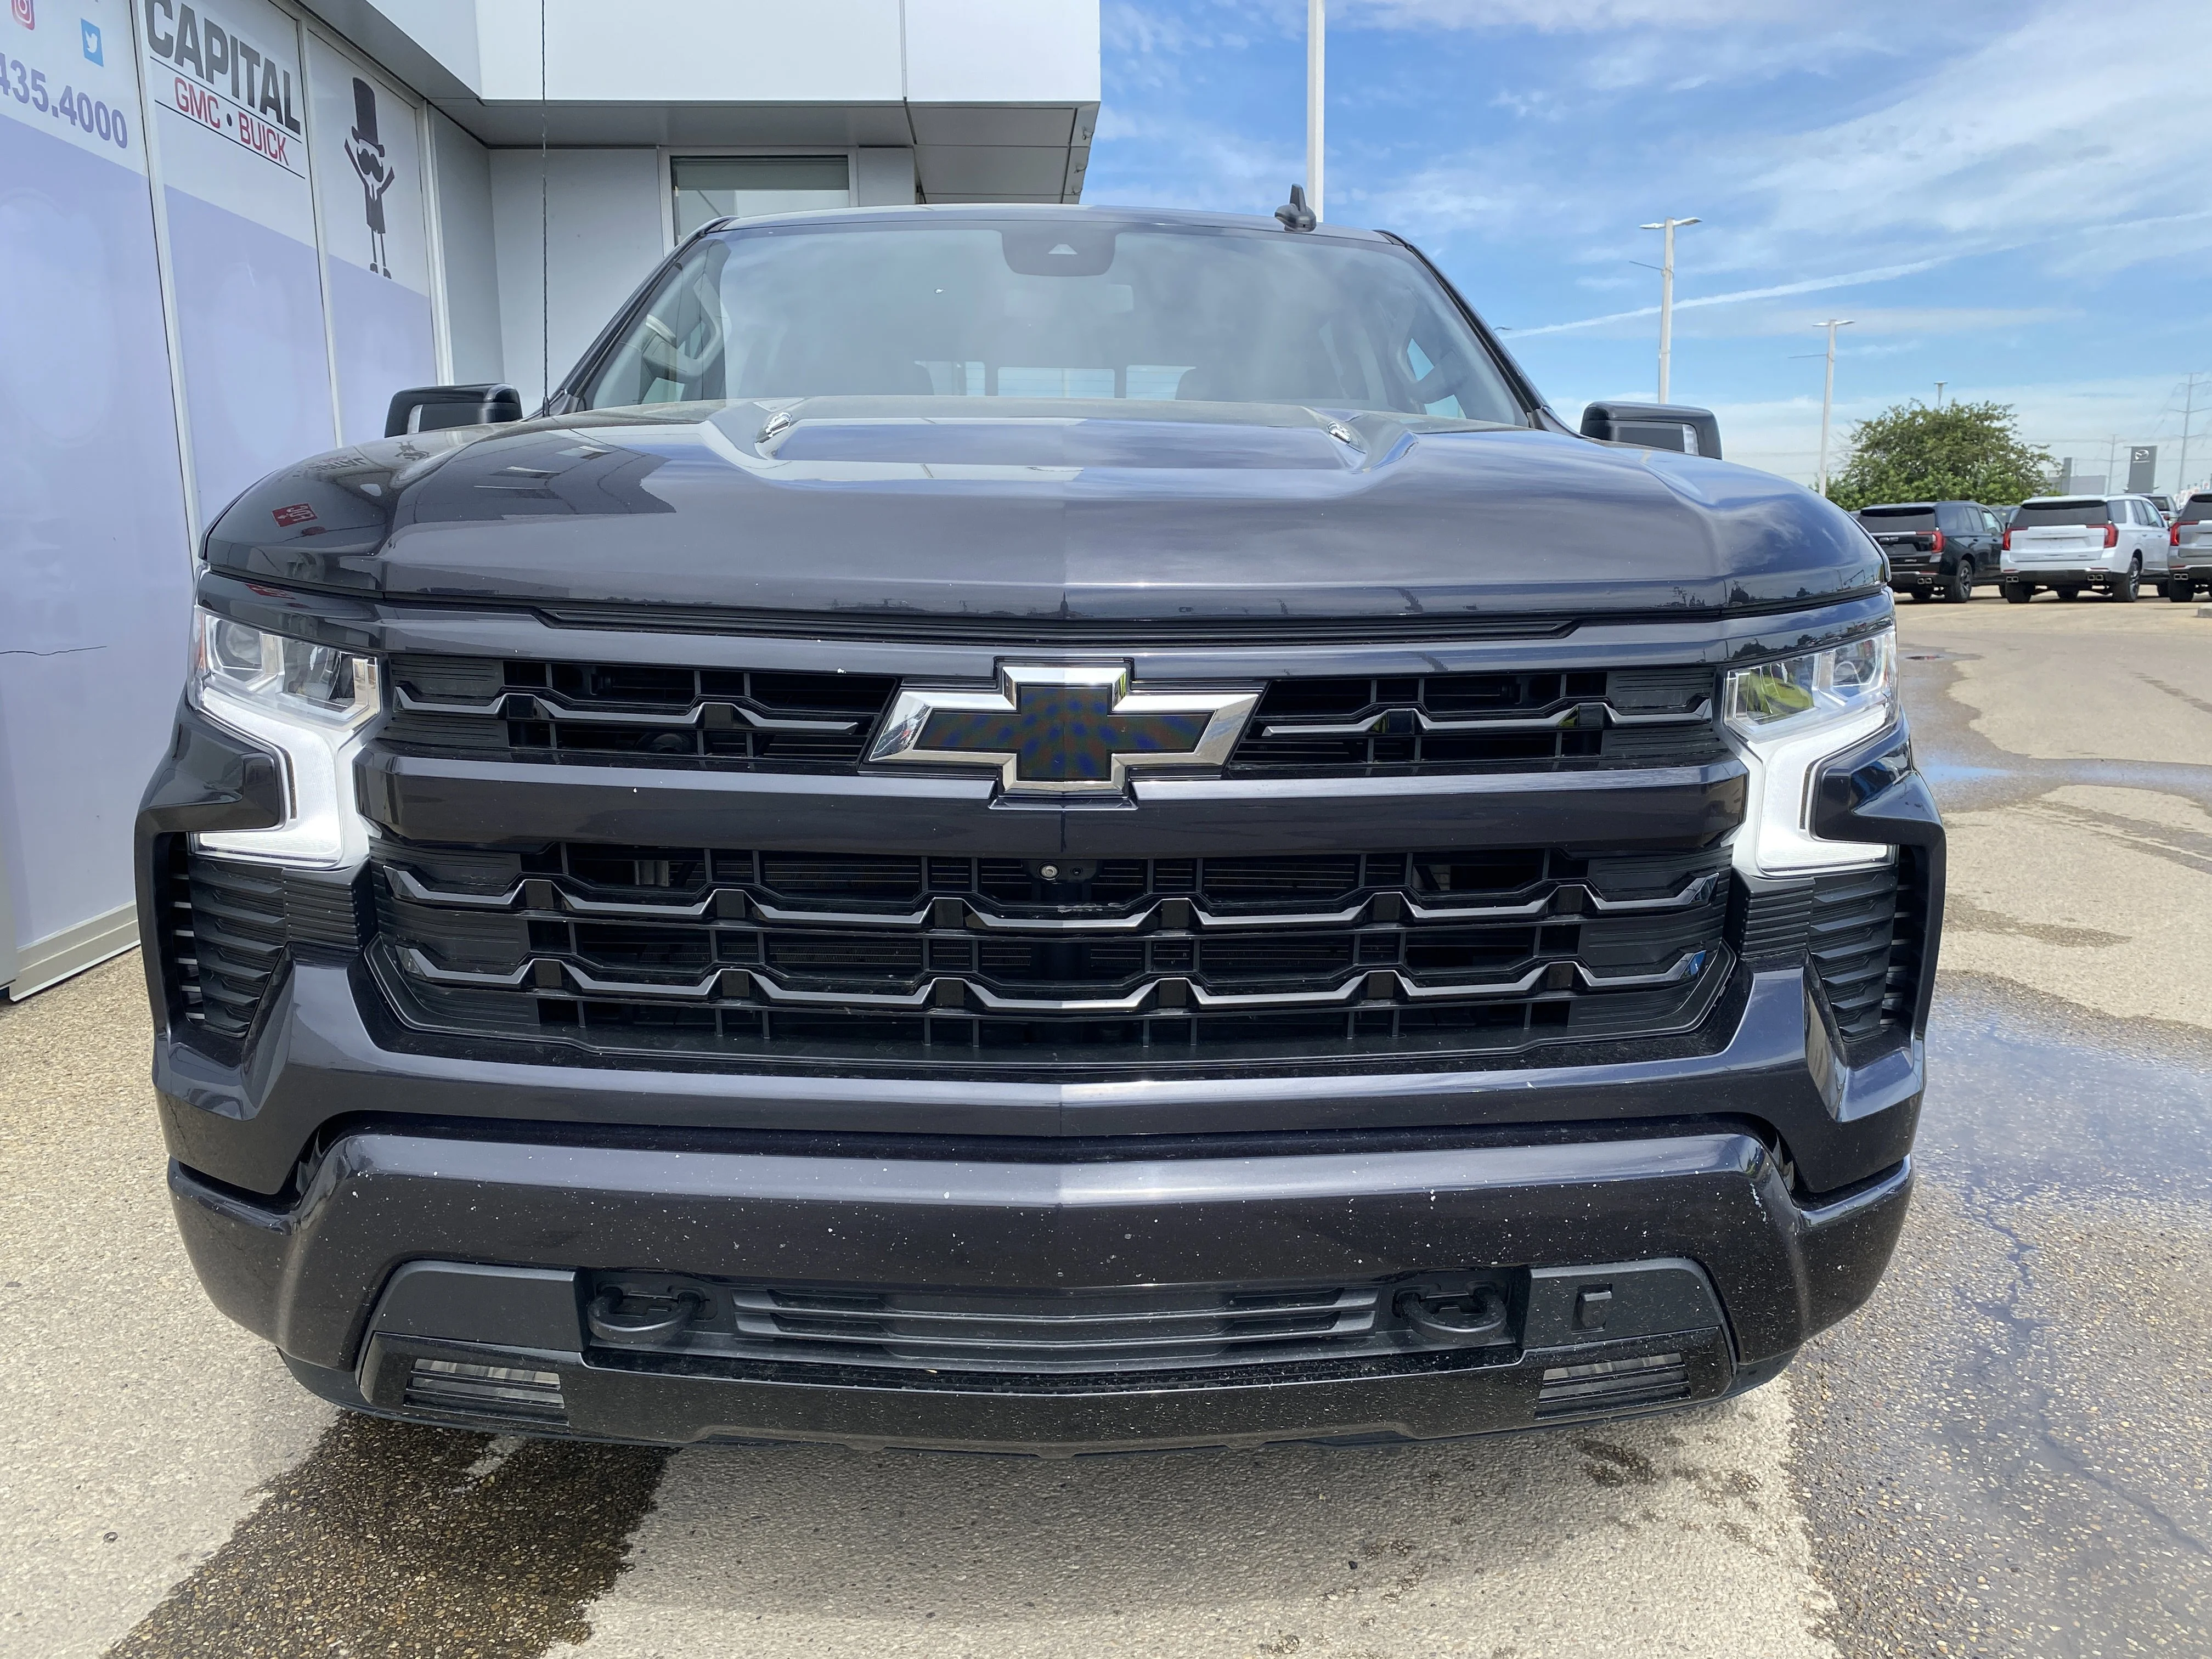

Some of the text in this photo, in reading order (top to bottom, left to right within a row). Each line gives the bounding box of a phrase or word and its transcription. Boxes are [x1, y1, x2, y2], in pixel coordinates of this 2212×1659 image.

[144, 0, 301, 136] CAPITAL
[174, 76, 289, 166] GMC BUICK
